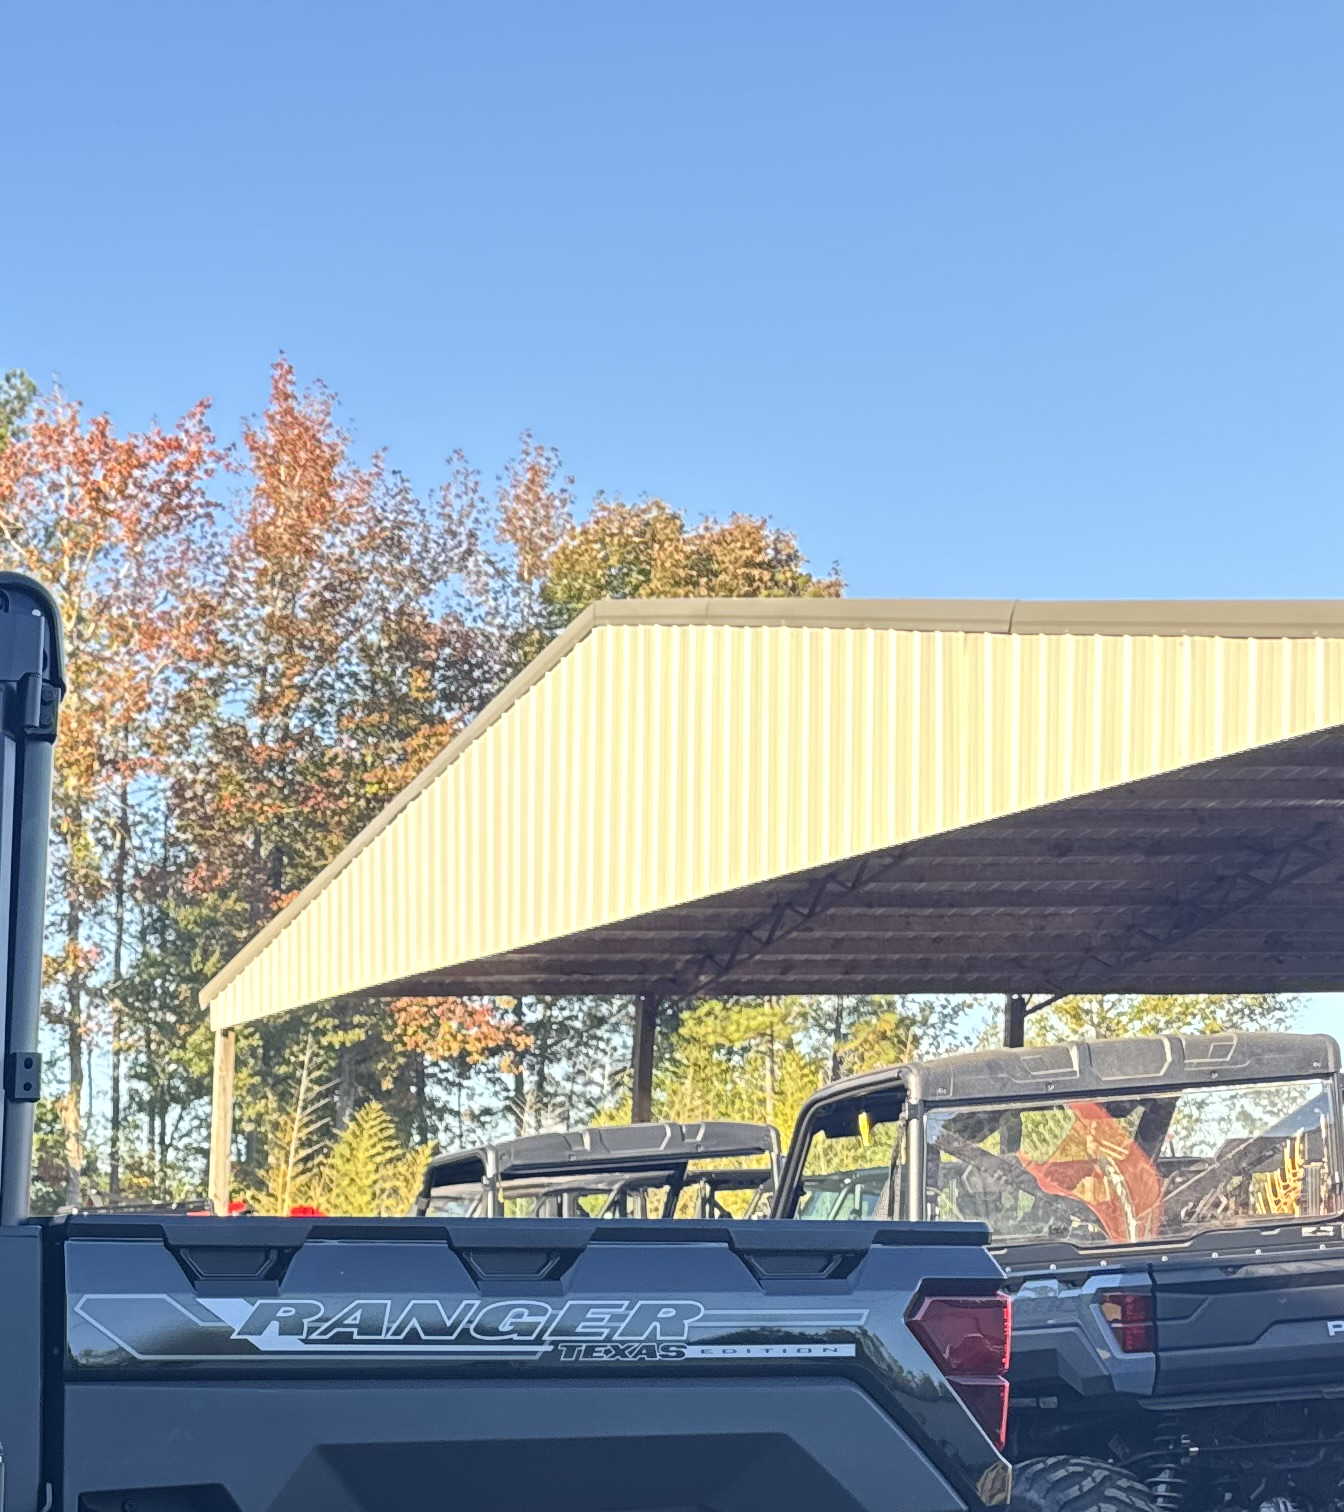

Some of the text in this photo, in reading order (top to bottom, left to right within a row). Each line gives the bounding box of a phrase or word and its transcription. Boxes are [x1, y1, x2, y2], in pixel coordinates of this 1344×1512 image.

[230, 1299, 705, 1341] RANGER
[557, 1343, 840, 1362] TEXAS EDITION
